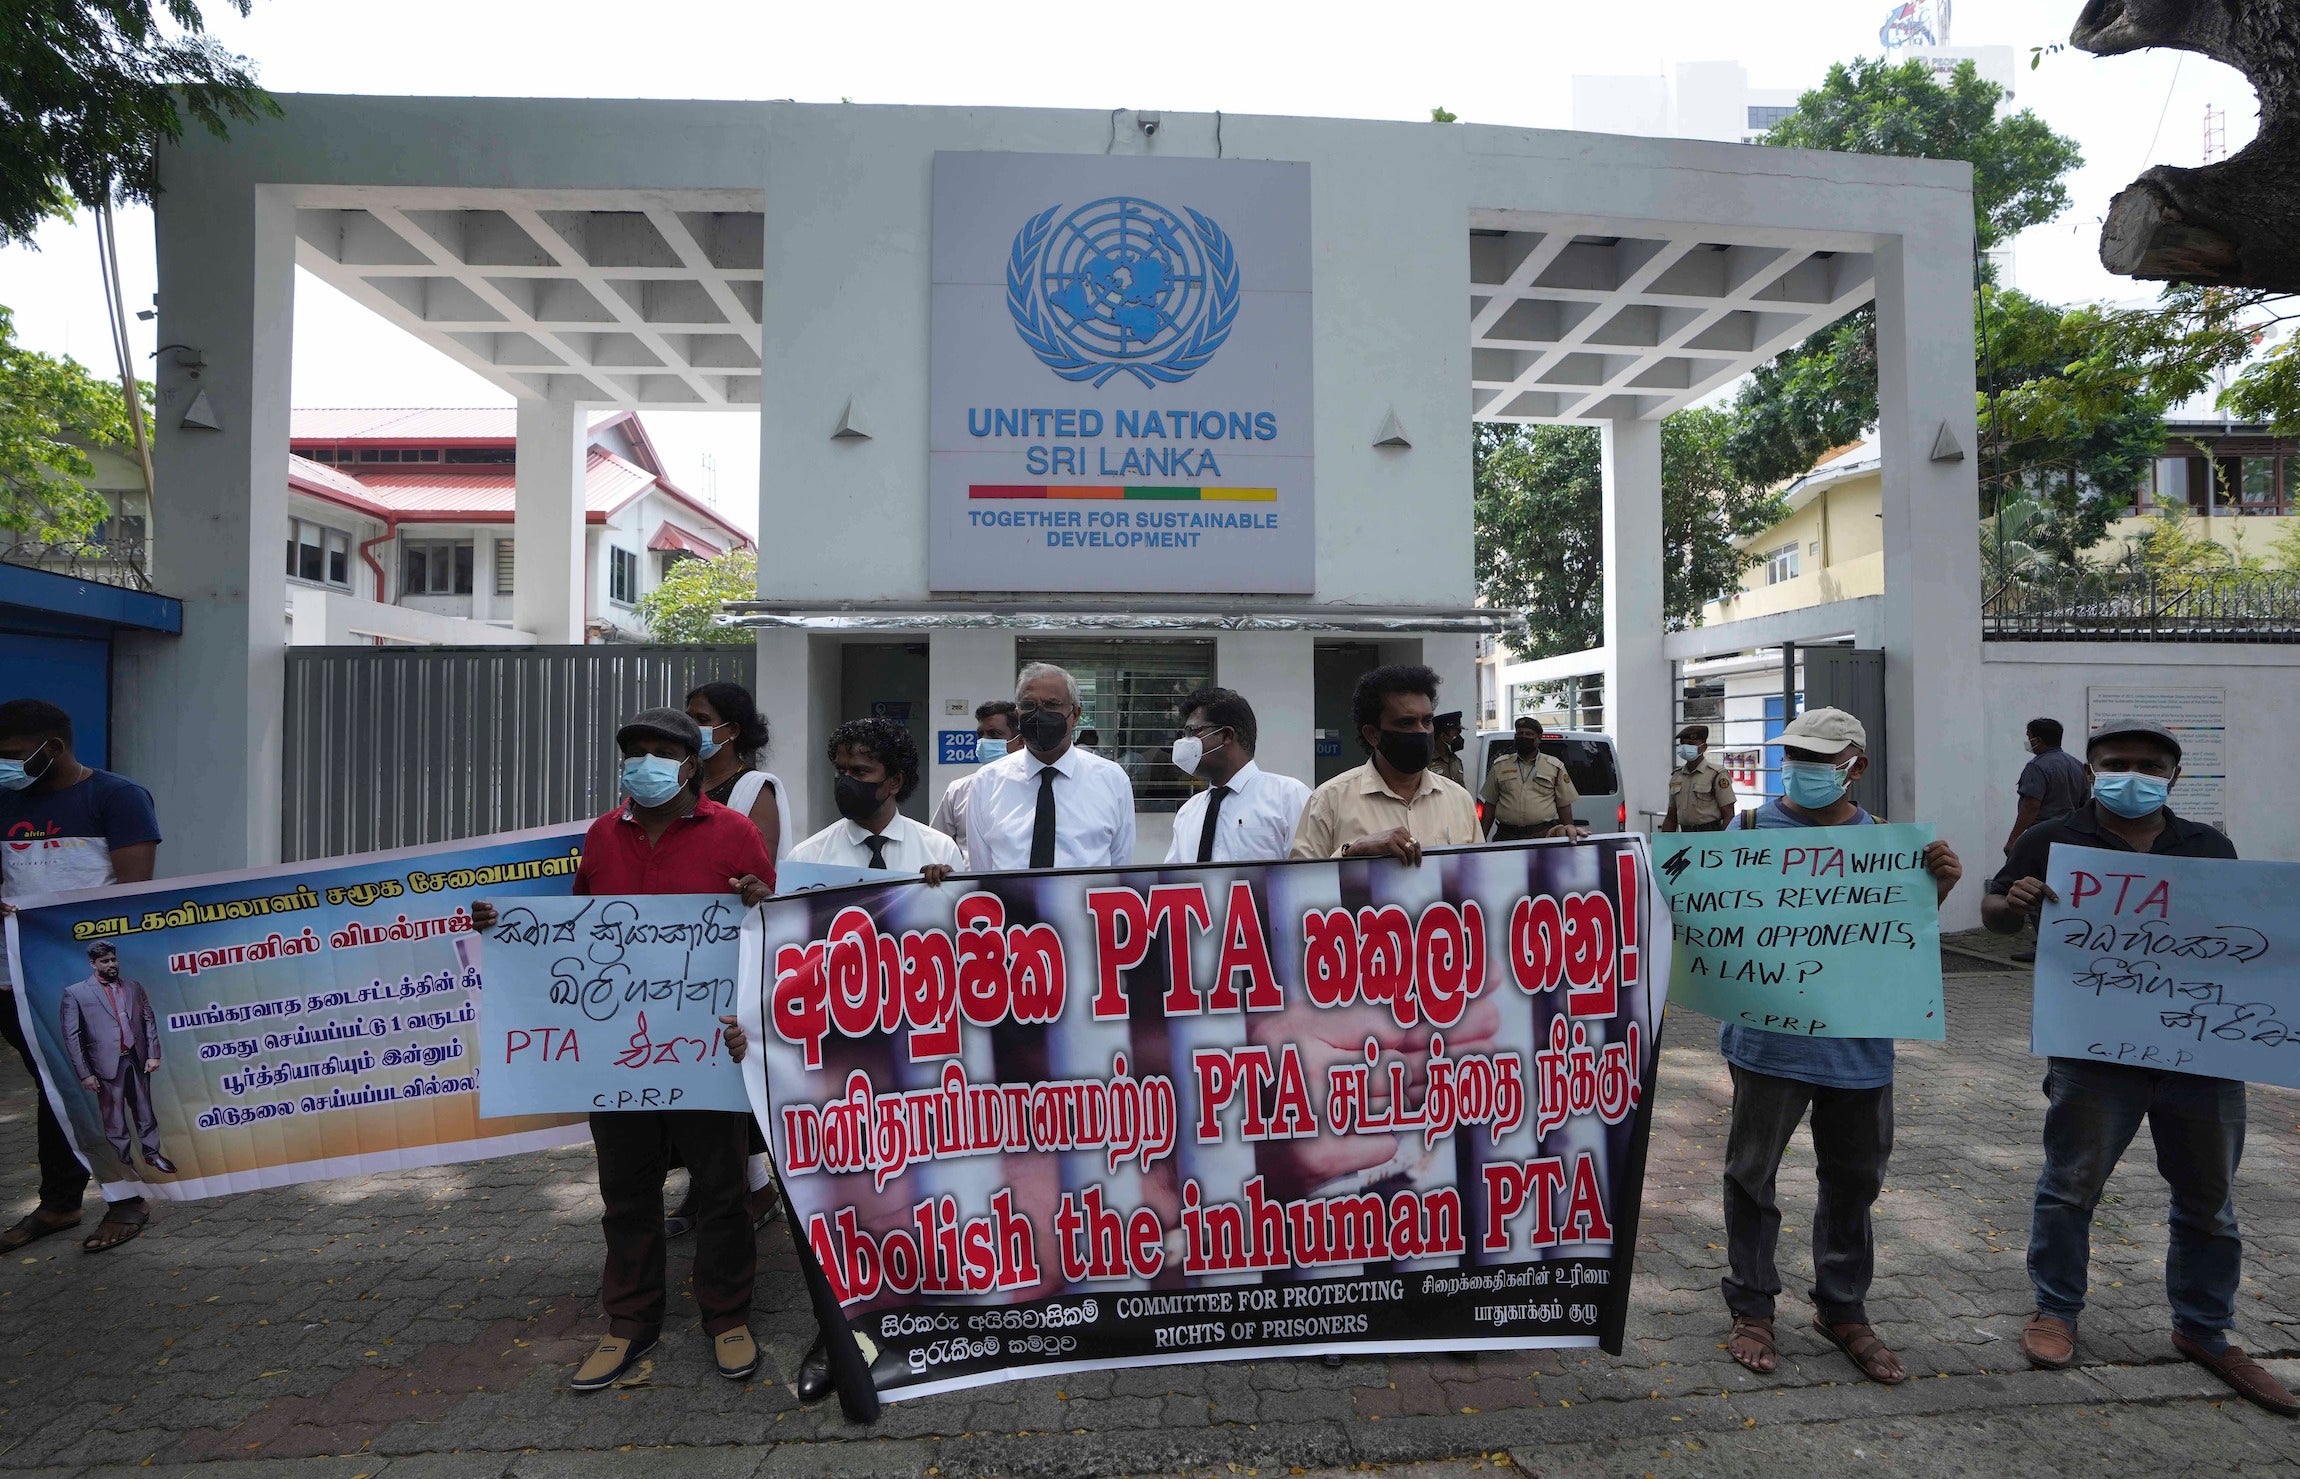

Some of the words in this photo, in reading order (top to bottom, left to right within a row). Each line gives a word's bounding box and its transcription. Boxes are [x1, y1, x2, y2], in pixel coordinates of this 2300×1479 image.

[968, 408, 1104, 437] UNITED
[1116, 410, 1278, 440] NATIONS
[1026, 446, 1086, 475] SRI
[1100, 447, 1221, 477] LANKA
[968, 511, 1081, 527] TOGETHER
[1088, 512, 1130, 528] FOR
[1136, 512, 1278, 529] SUSTAINABLE
[1047, 531, 1201, 548] DEVELOPMENT
[945, 733, 975, 746] 202
[945, 749, 975, 761] 204
[1317, 744, 1338, 754] OUT
[1700, 849, 1723, 868] IS
[1730, 848, 1772, 869] THE
[1781, 846, 1845, 878] PTA
[1850, 850, 1927, 874] WHICH
[73, 885, 320, 941] ஊடகவியலாளர்
[326, 879, 404, 906] சமூக
[408, 847, 583, 894] சேவையாளர்
[1670, 888, 1764, 914] ENACTS
[1777, 885, 1908, 909] REVENGE
[2069, 870, 2170, 919] PTA
[170, 927, 321, 976] யுவானிஸ்
[330, 907, 474, 950] விமல்ராஜ்
[1672, 924, 1744, 948] FROM
[1756, 919, 1916, 950] OPPONENTS,
[772, 891, 1066, 1070] අමානුෂික
[1085, 879, 1284, 1021] PTA
[170, 999, 302, 1029] பயங்கரவாத
[200, 1039, 259, 1059] கைது
[264, 1017, 387, 1050] செய்யப்பட்டு
[391, 1016, 402, 1031] 1
[407, 1002, 476, 1030] வருடம்
[506, 1028, 580, 1064] PTA
[223, 1050, 376, 1095] பூர்த்தியாகியும்
[381, 1037, 463, 1066] இன்னும்
[198, 1101, 295, 1128] விடுதலை
[782, 1051, 1178, 1193] மனிதாபிமானமற்ற
[1193, 1043, 1318, 1144] PTA
[1327, 1032, 1525, 1152] சட்டத்தை
[1535, 1013, 1641, 1143] நீக்கு!
[808, 1187, 1042, 1308] Abolish
[1055, 1183, 1166, 1283] the
[1181, 1174, 1467, 1277] inhuman
[1482, 1152, 1614, 1254] PTA
[1421, 1265, 1551, 1297] சிறைக்கைதிகளின்
[1555, 1262, 1610, 1288] உரிமை
[1116, 1292, 1234, 1319] COMMITTEE
[1238, 1287, 1278, 1313] FOR
[1282, 1278, 1405, 1309] PROTECTING
[1474, 1298, 1563, 1327] பாதுகாக்கும்
[1568, 1303, 1598, 1326] குழு
[1231, 1321, 1257, 1341] OF
[1262, 1313, 1369, 1339] PRISONERS
[1008, 1335, 1078, 1357] කමිටුව
